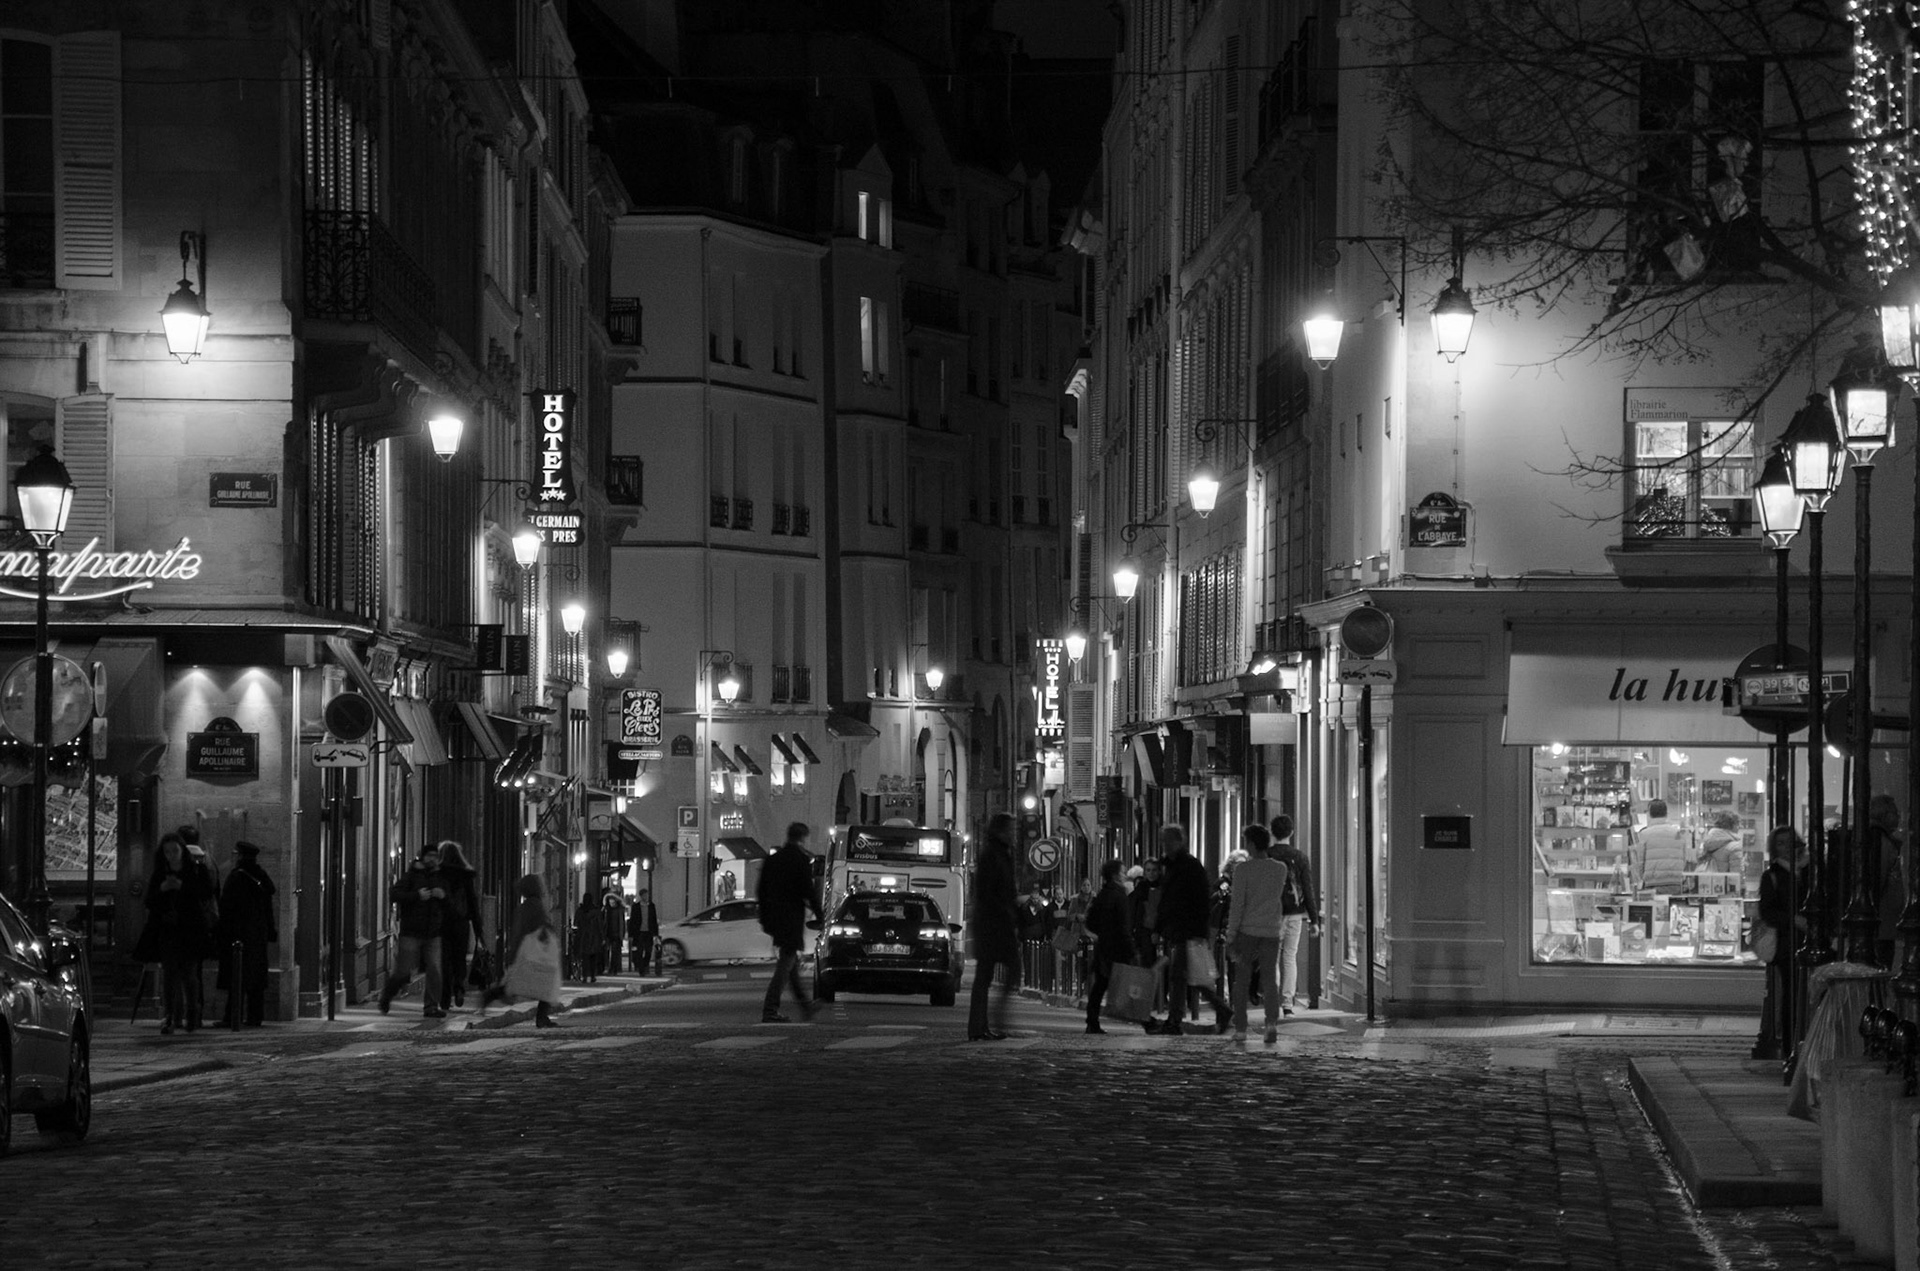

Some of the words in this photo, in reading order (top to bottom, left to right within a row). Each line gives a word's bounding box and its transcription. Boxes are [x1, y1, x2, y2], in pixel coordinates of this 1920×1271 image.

[1629, 400, 1667, 409] librairie
[1630, 409, 1688, 419] Flammarion
[542, 394, 564, 488] HOTEL
[235, 480, 251, 490] RUE
[536, 515, 580, 528] GERMAIN
[1429, 514, 1447, 523] RUE
[552, 530, 577, 543] PRES
[1418, 531, 1457, 541] L'ABBAYE
[1045, 652, 1059, 710] HOTEL
[1608, 667, 1649, 702] la
[1662, 668, 1723, 702] hu
[1764, 679, 1778, 689] 39
[1782, 678, 1794, 688] 95
[627, 690, 659, 699] BISTRO
[624, 699, 643, 717] Le
[643, 698, 660, 717] Pré
[215, 737, 231, 746] RUE
[623, 735, 659, 743] BRASSERIE
[201, 747, 245, 756] GUILLAUME
[199, 757, 246, 766] APOLLINAIRE
[683, 810, 694, 825] P
[922, 839, 940, 854] 95
